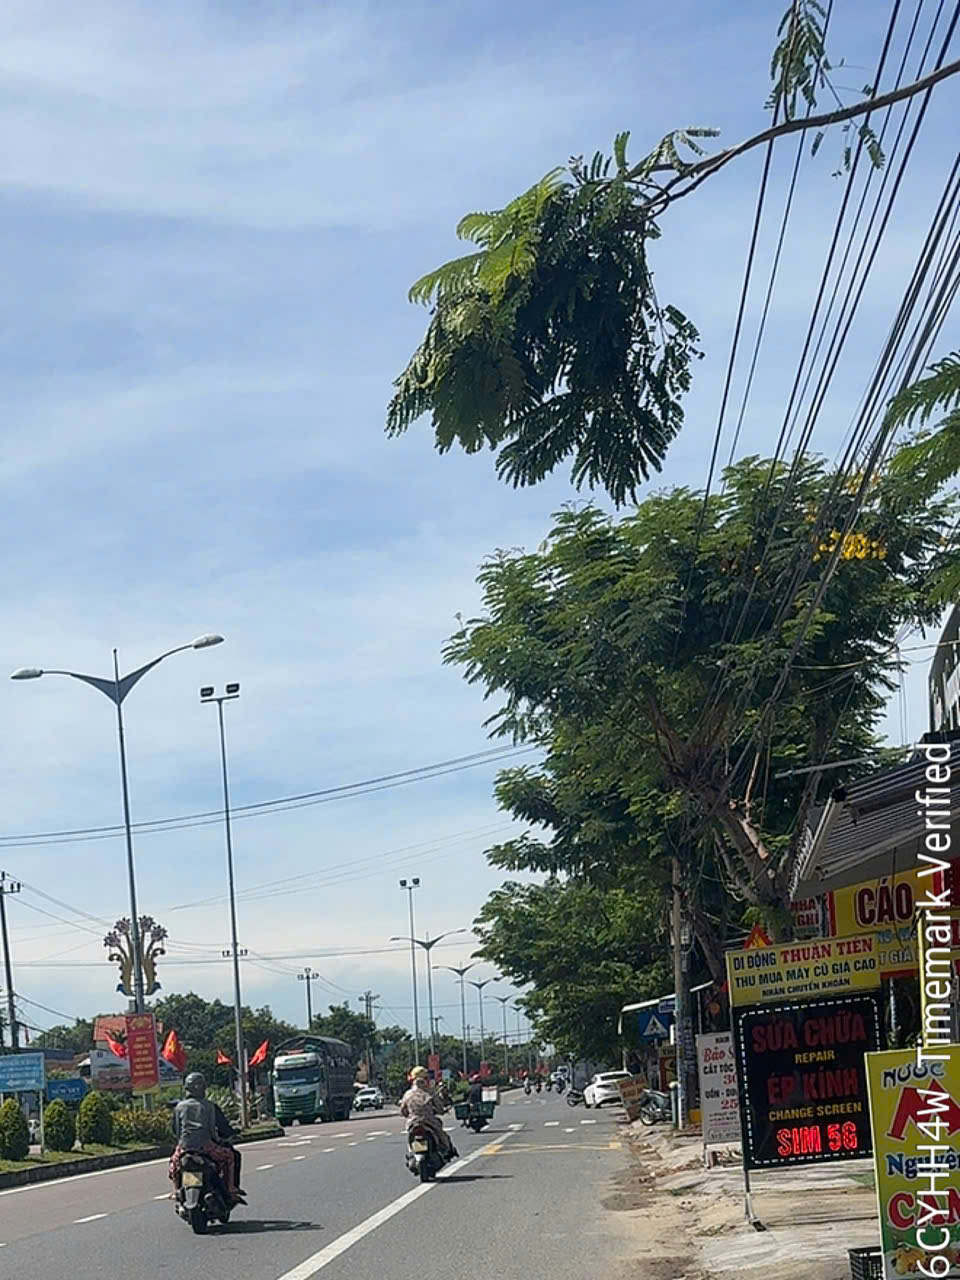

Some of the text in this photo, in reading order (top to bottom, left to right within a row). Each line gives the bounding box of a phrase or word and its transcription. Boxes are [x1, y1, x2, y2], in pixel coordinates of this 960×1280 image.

[733, 957, 744, 971] DI
[747, 950, 776, 970] ĐỘNG
[780, 942, 831, 963] THUẬN
[735, 957, 876, 988] THU MUA MÁY CŨ GIÁ CAO
[752, 1010, 866, 1053] SỬA CHỮA
[795, 1050, 835, 1064] REPAIR
[767, 1066, 858, 1104] ÉP KÍNH
[768, 1102, 862, 1122] CHANGE SCREEN
[777, 1121, 858, 1156] SIM 5G
[886, 1146, 960, 1179] Nguyê
